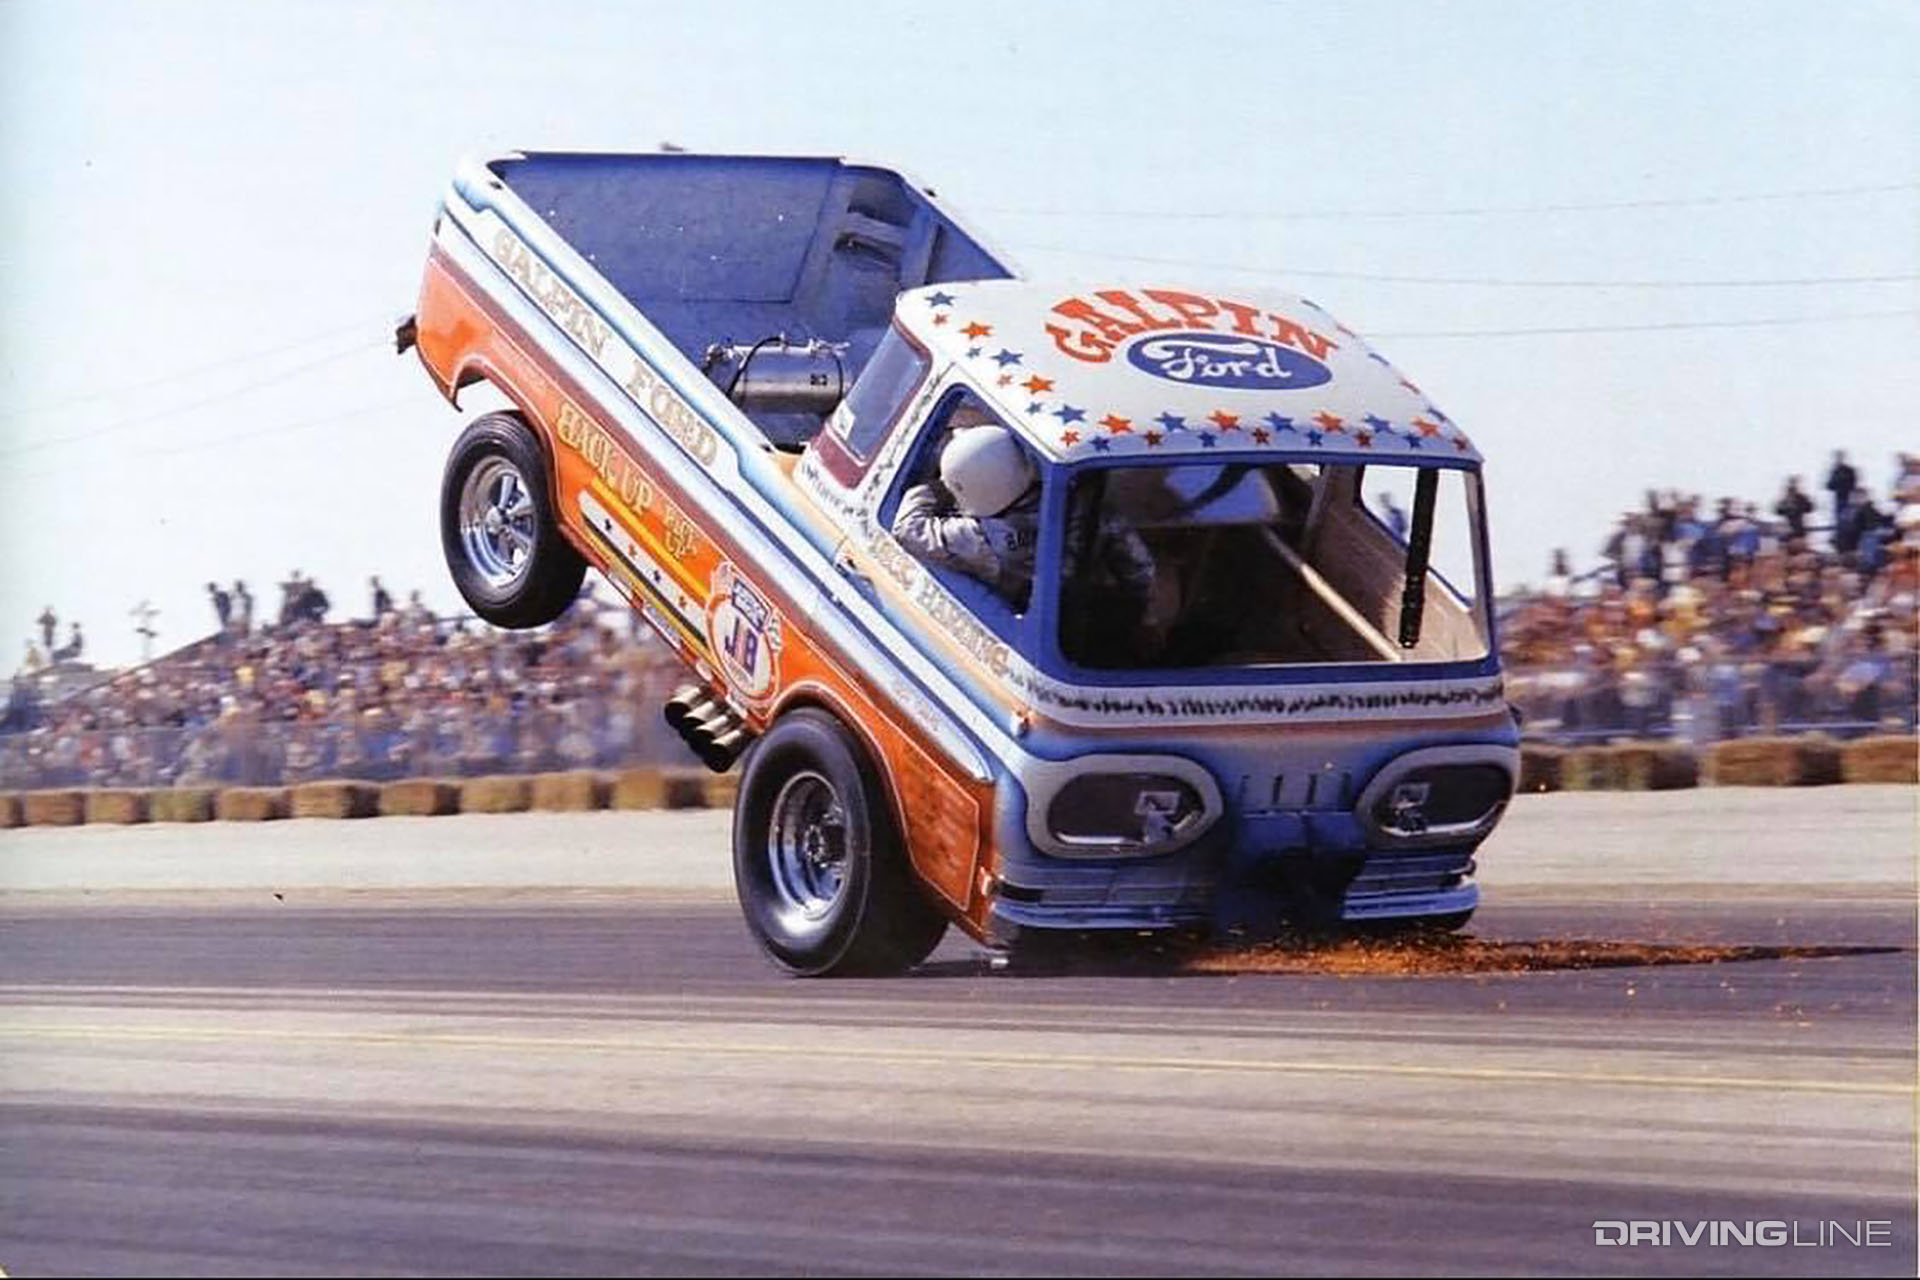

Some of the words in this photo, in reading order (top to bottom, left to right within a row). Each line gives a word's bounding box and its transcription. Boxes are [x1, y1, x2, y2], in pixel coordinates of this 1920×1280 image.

[496, 227, 614, 355] GALPIN
[624, 358, 718, 467] FORD
[1045, 289, 1340, 363] GALPIN
[1141, 339, 1293, 380] Ford
[621, 462, 653, 516] UP
